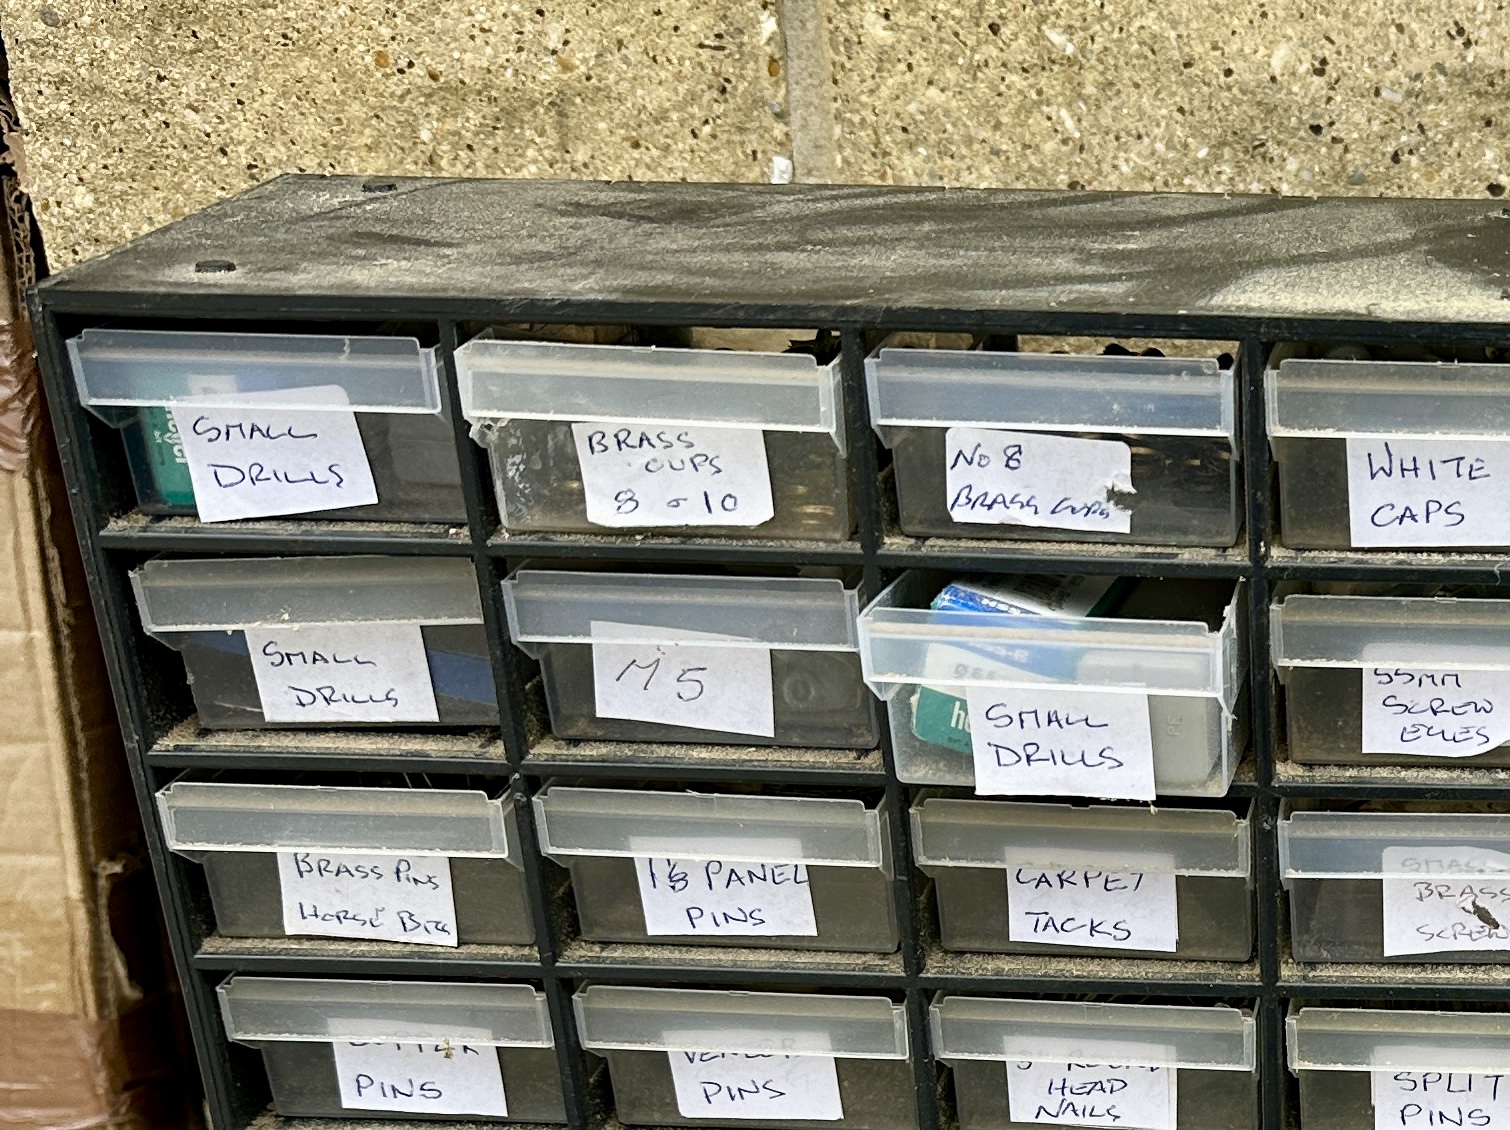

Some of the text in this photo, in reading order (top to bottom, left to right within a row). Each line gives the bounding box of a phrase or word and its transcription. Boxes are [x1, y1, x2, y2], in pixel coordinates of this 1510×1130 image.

[194, 416, 318, 442] SMALL
[588, 430, 696, 455] BRASS
[644, 454, 723, 475] CUPS
[1004, 444, 1022, 469] 8
[1367, 442, 1490, 482] WHITE
[208, 463, 344, 488] DRILLS
[615, 489, 640, 514] 8
[705, 490, 738, 512] 10
[950, 484, 1040, 516] BRASS
[1369, 501, 1465, 528] CAPS
[263, 641, 378, 667] SMALL
[288, 685, 399, 709] DRILLS
[1381, 695, 1494, 716] SCREW
[985, 702, 1109, 729] SMALL
[987, 741, 1123, 770] DRILLS
[294, 852, 383, 881] BRASS
[705, 860, 811, 891] PANEL
[1015, 868, 1143, 893] CARPET
[687, 906, 766, 930] PINS
[1025, 911, 1132, 941] TACKS
[356, 1073, 443, 1100] PINS
[703, 1079, 787, 1105] PINS
[1047, 1077, 1128, 1097] HEAD
[1393, 1072, 1504, 1101] SPLIT
[1035, 1098, 1121, 1122] NAILS
[1399, 1103, 1492, 1128] PINS
